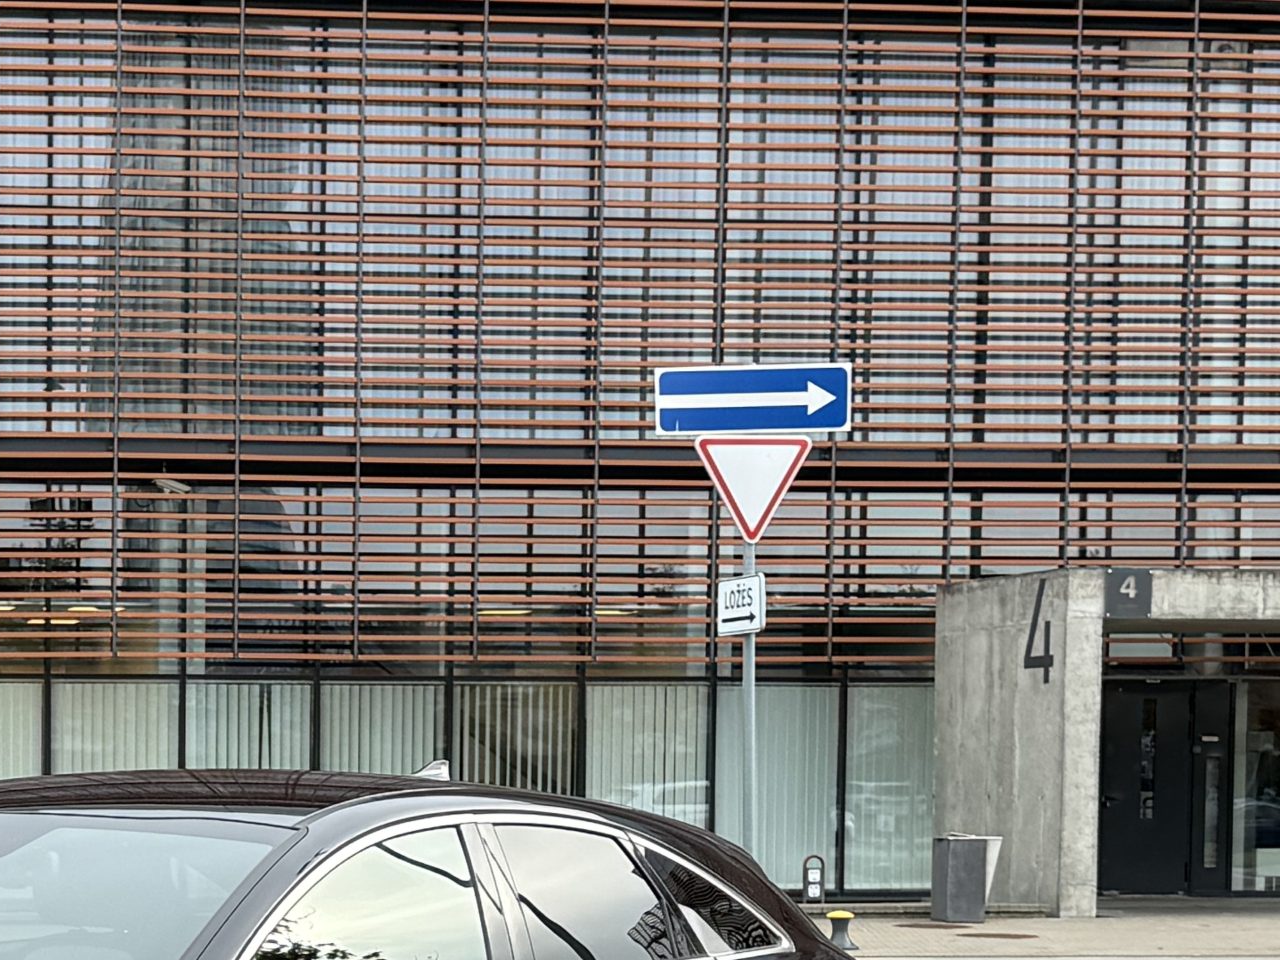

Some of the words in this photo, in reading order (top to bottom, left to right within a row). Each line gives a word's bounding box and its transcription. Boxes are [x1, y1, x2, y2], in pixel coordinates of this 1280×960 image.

[724, 583, 754, 610] LOŽĖS
[1119, 575, 1138, 599] 4
[1023, 578, 1054, 685] 4
